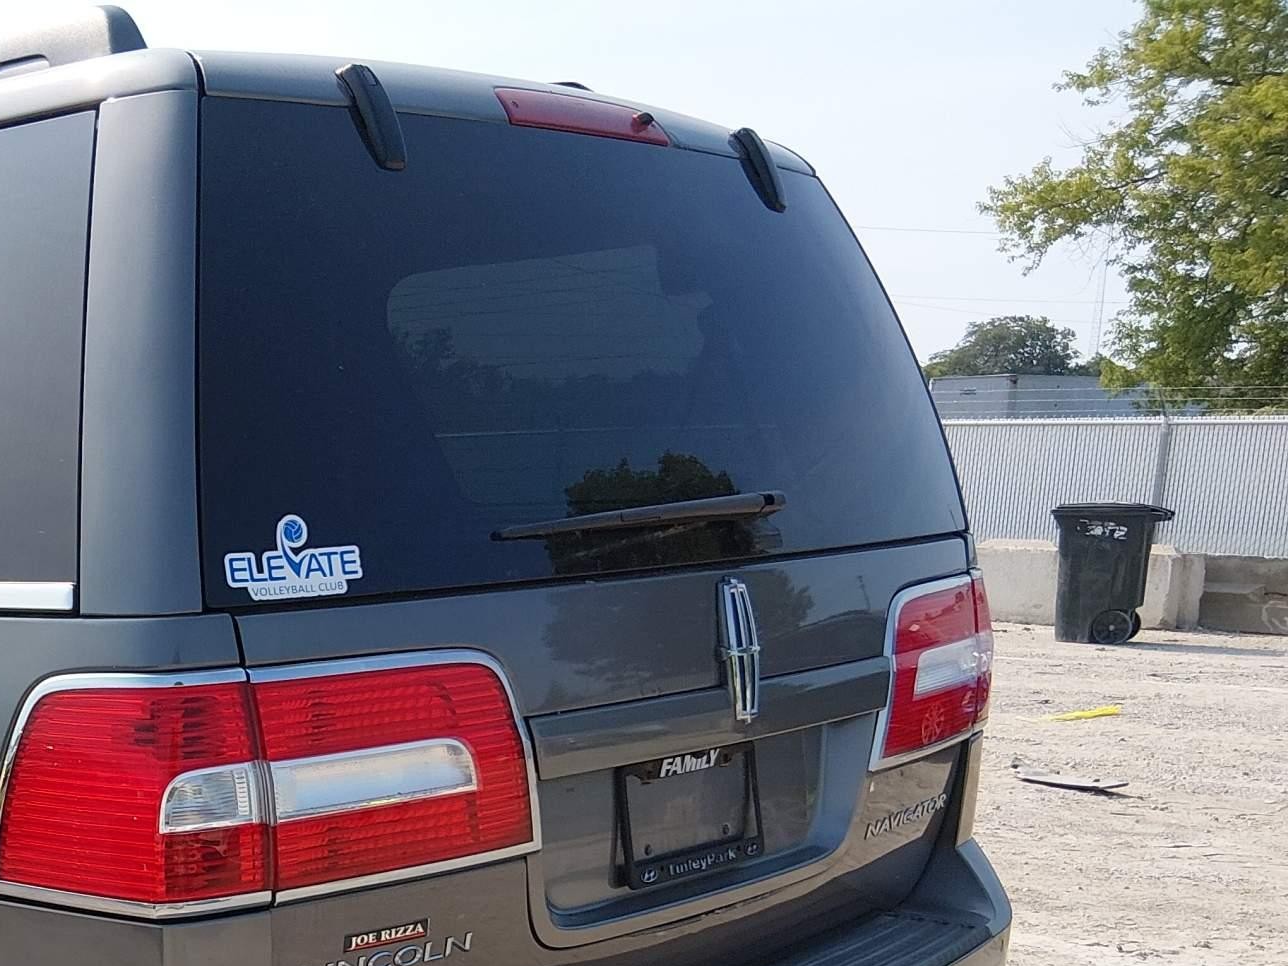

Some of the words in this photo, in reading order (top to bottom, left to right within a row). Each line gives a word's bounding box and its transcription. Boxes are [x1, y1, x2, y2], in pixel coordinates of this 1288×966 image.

[227, 547, 360, 584] ELEVATE
[252, 584, 316, 598] VOLLEYBALL
[318, 581, 345, 592] CLUB
[864, 792, 948, 840] NAVIGATOR
[351, 932, 377, 950] JOE
[380, 923, 424, 940] RIZZA
